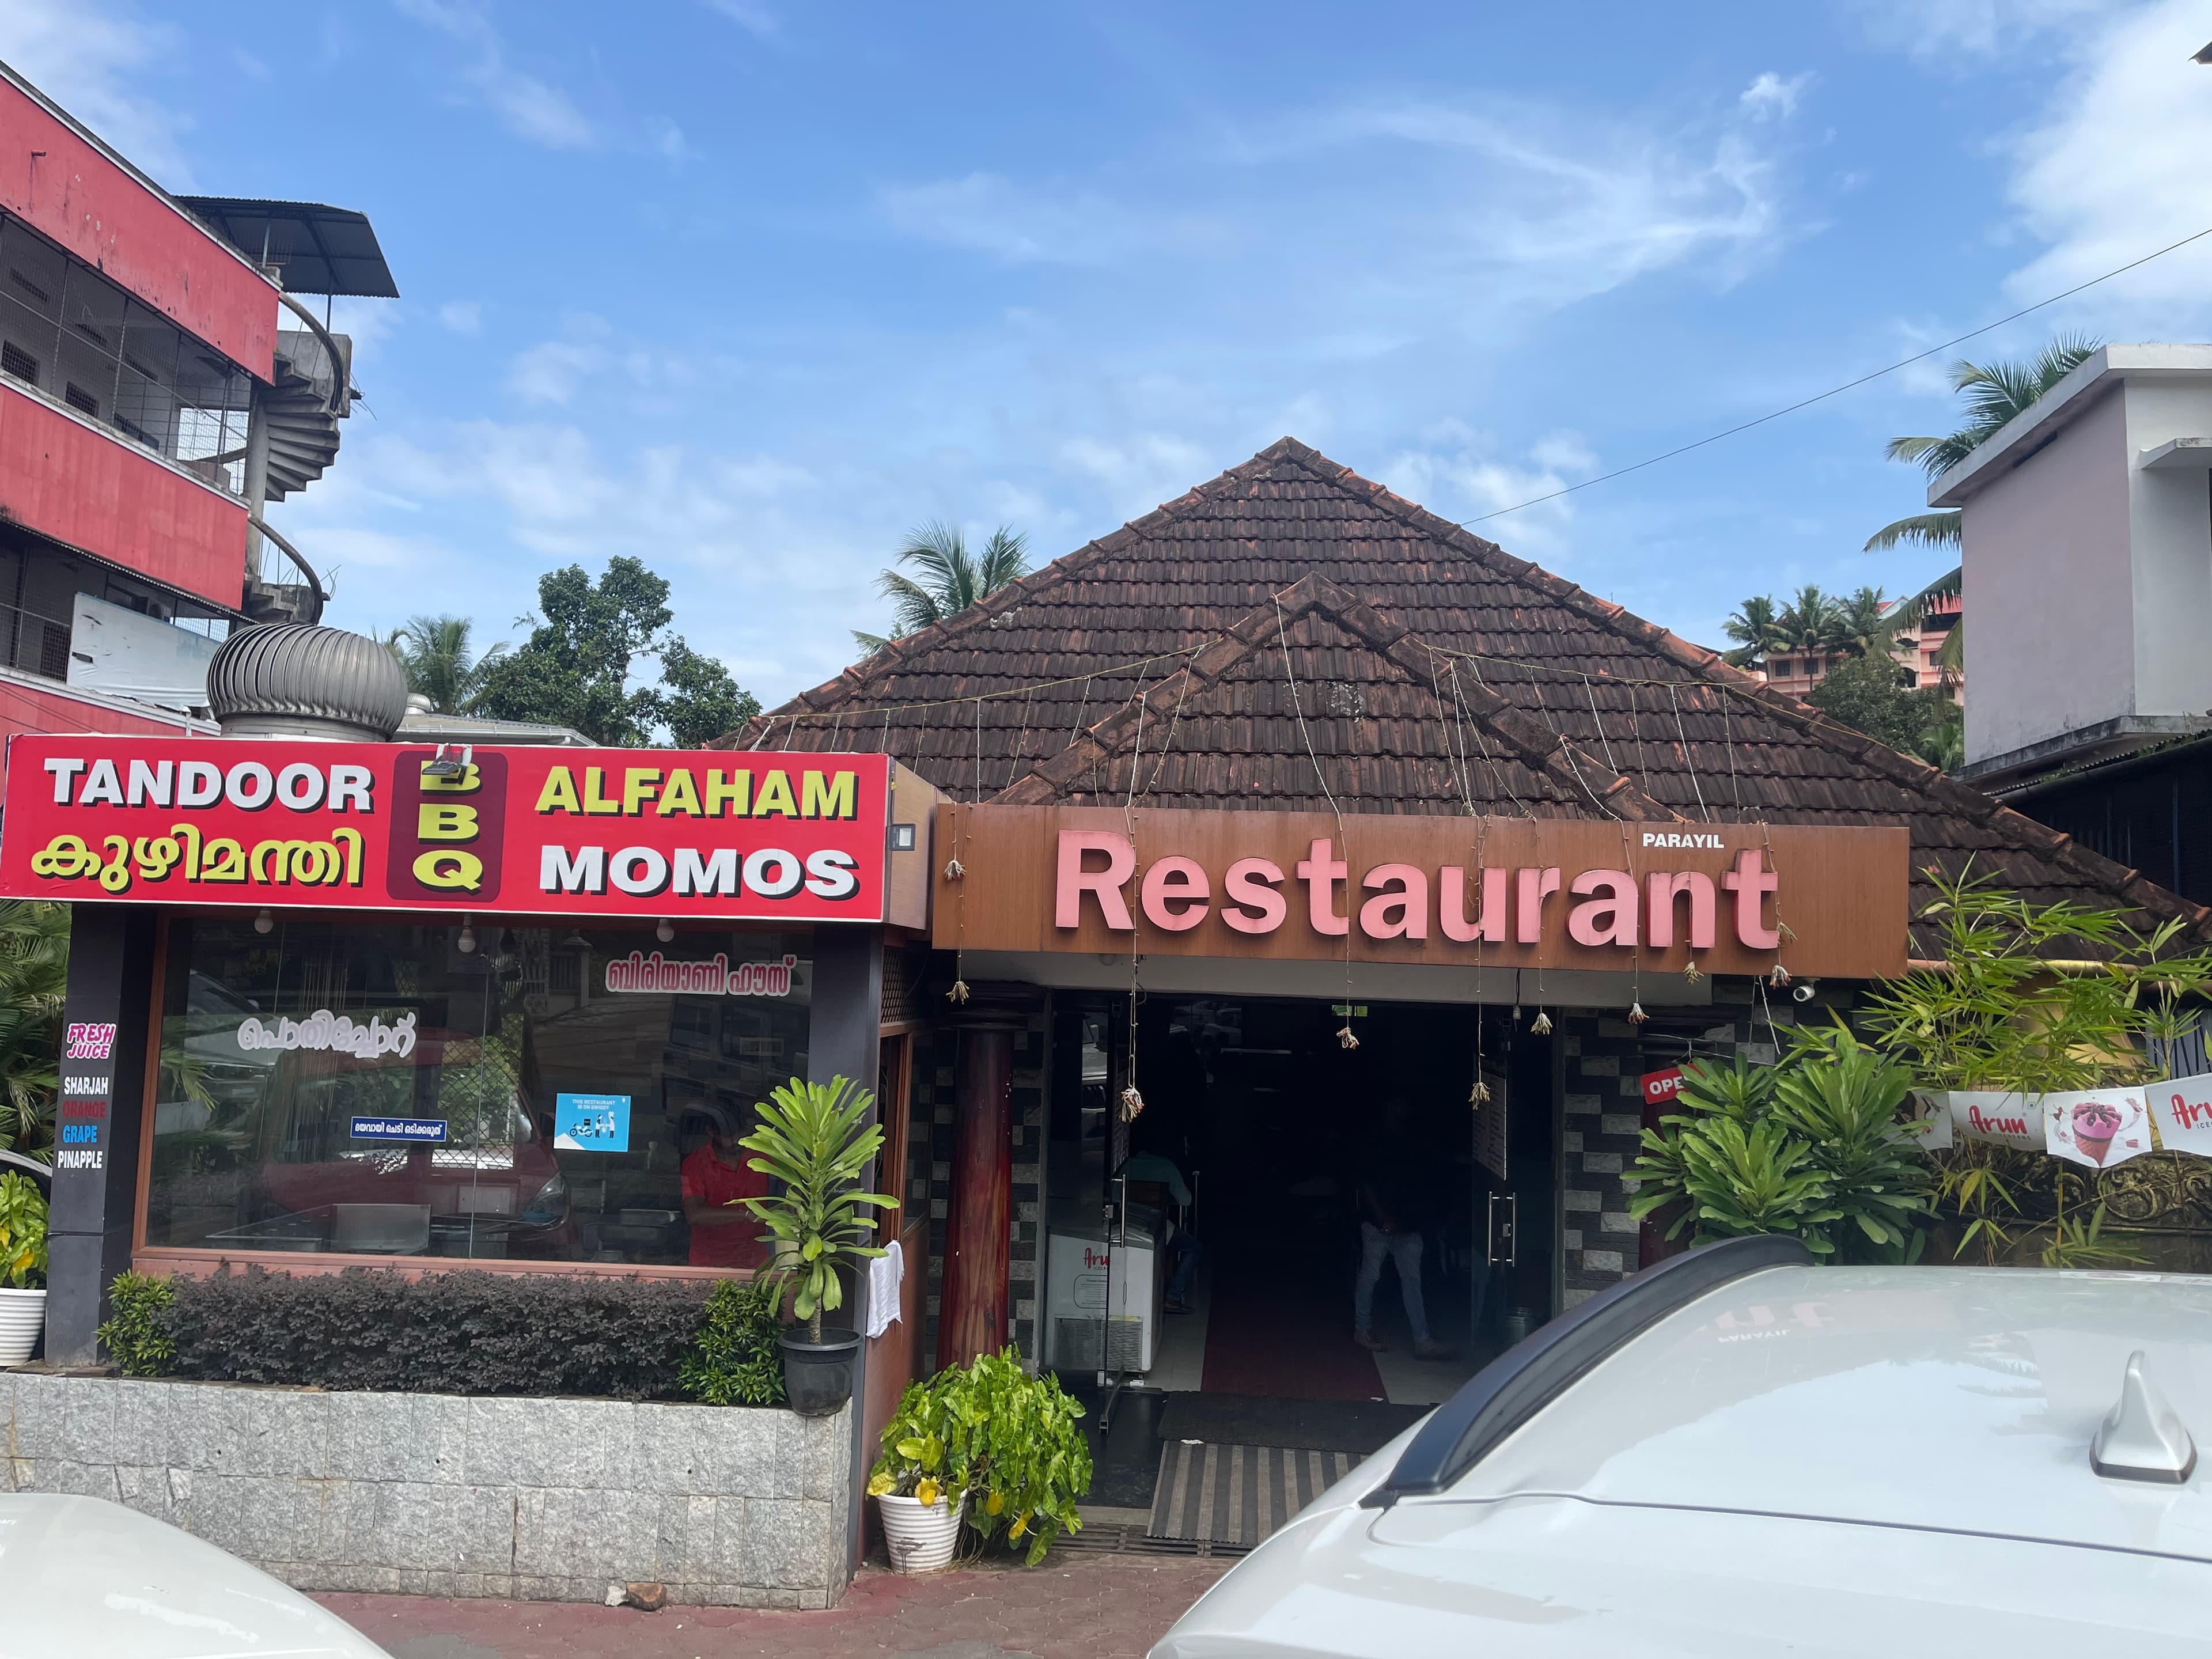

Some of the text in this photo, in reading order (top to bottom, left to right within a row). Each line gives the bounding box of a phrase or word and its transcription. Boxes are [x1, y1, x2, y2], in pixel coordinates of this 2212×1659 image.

[44, 758, 373, 812] TANDOOR
[535, 766, 857, 818] ALFAHAM
[412, 760, 482, 892] BBQ
[1642, 833, 1724, 849] PARAYIL
[31, 824, 363, 892] കുഴിമന്തി
[540, 845, 858, 899] MOMOS
[1055, 830, 1778, 949] Restaurant
[607, 952, 726, 992] ബിരിയാണി
[67, 1022, 116, 1044] FRESH
[67, 1043, 110, 1059] JUICE
[64, 1077, 108, 1094] SHARJAH
[1649, 1075, 1690, 1094] OPE
[62, 1101, 106, 1118] ORANGE
[1968, 1105, 2028, 1134] Arun
[63, 1125, 97, 1143] GRAPE
[355, 1122, 385, 1133] ദയവായി
[2196, 1120, 2212, 1130] ICE
[58, 1150, 103, 1169] PINAPPLE
[1084, 1247, 1109, 1269] Aru
